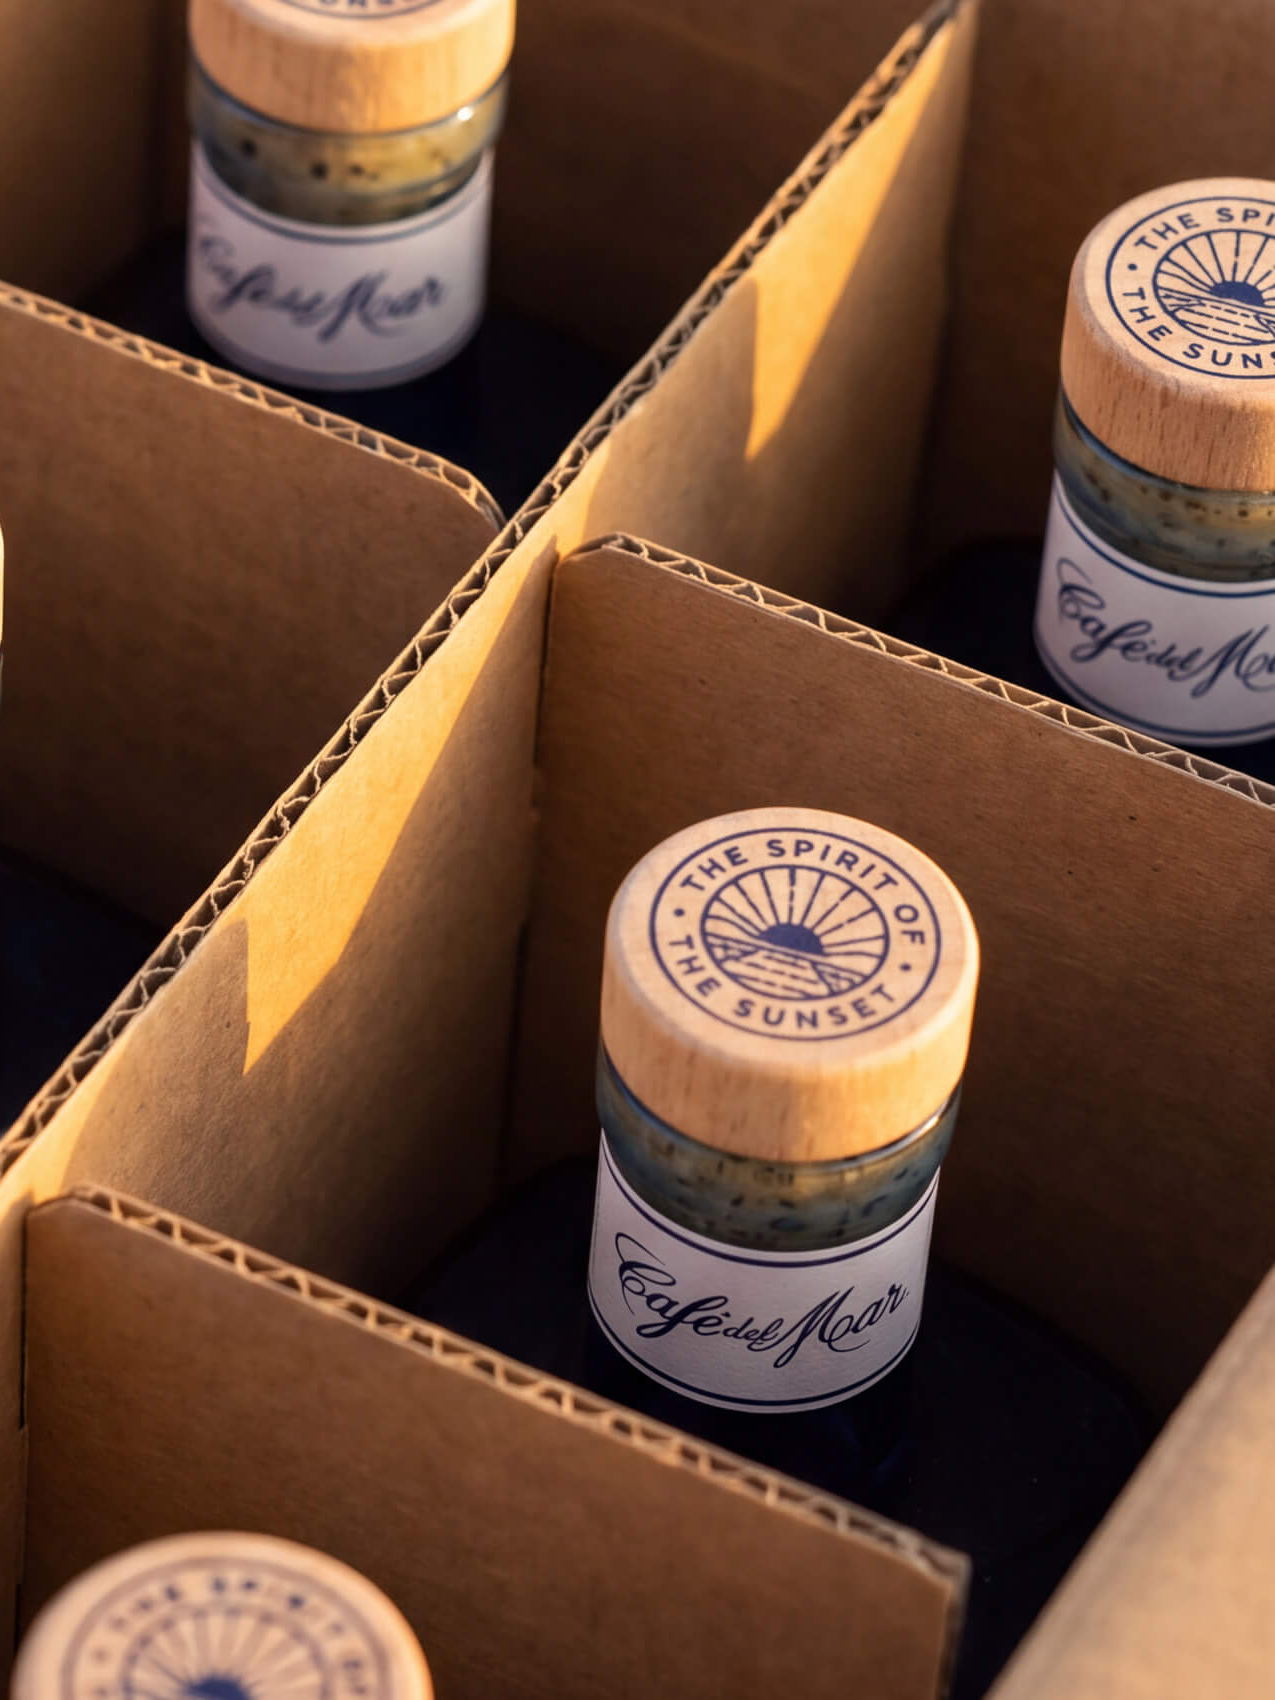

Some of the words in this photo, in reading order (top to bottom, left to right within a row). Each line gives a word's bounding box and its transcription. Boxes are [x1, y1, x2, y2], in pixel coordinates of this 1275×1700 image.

[1133, 212, 1201, 251] THE
[1215, 207, 1275, 227] SPI
[1122, 287, 1174, 342] THE
[1182, 342, 1275, 370] SUN
[679, 845, 750, 894] THE
[765, 838, 900, 892] SPIRIT
[893, 904, 926, 946] OF
[668, 935, 722, 998] THE
[732, 982, 897, 1030] SUNSET
[614, 1231, 732, 1338] Café
[747, 1282, 911, 1369] Mar
[722, 1316, 785, 1341] del
